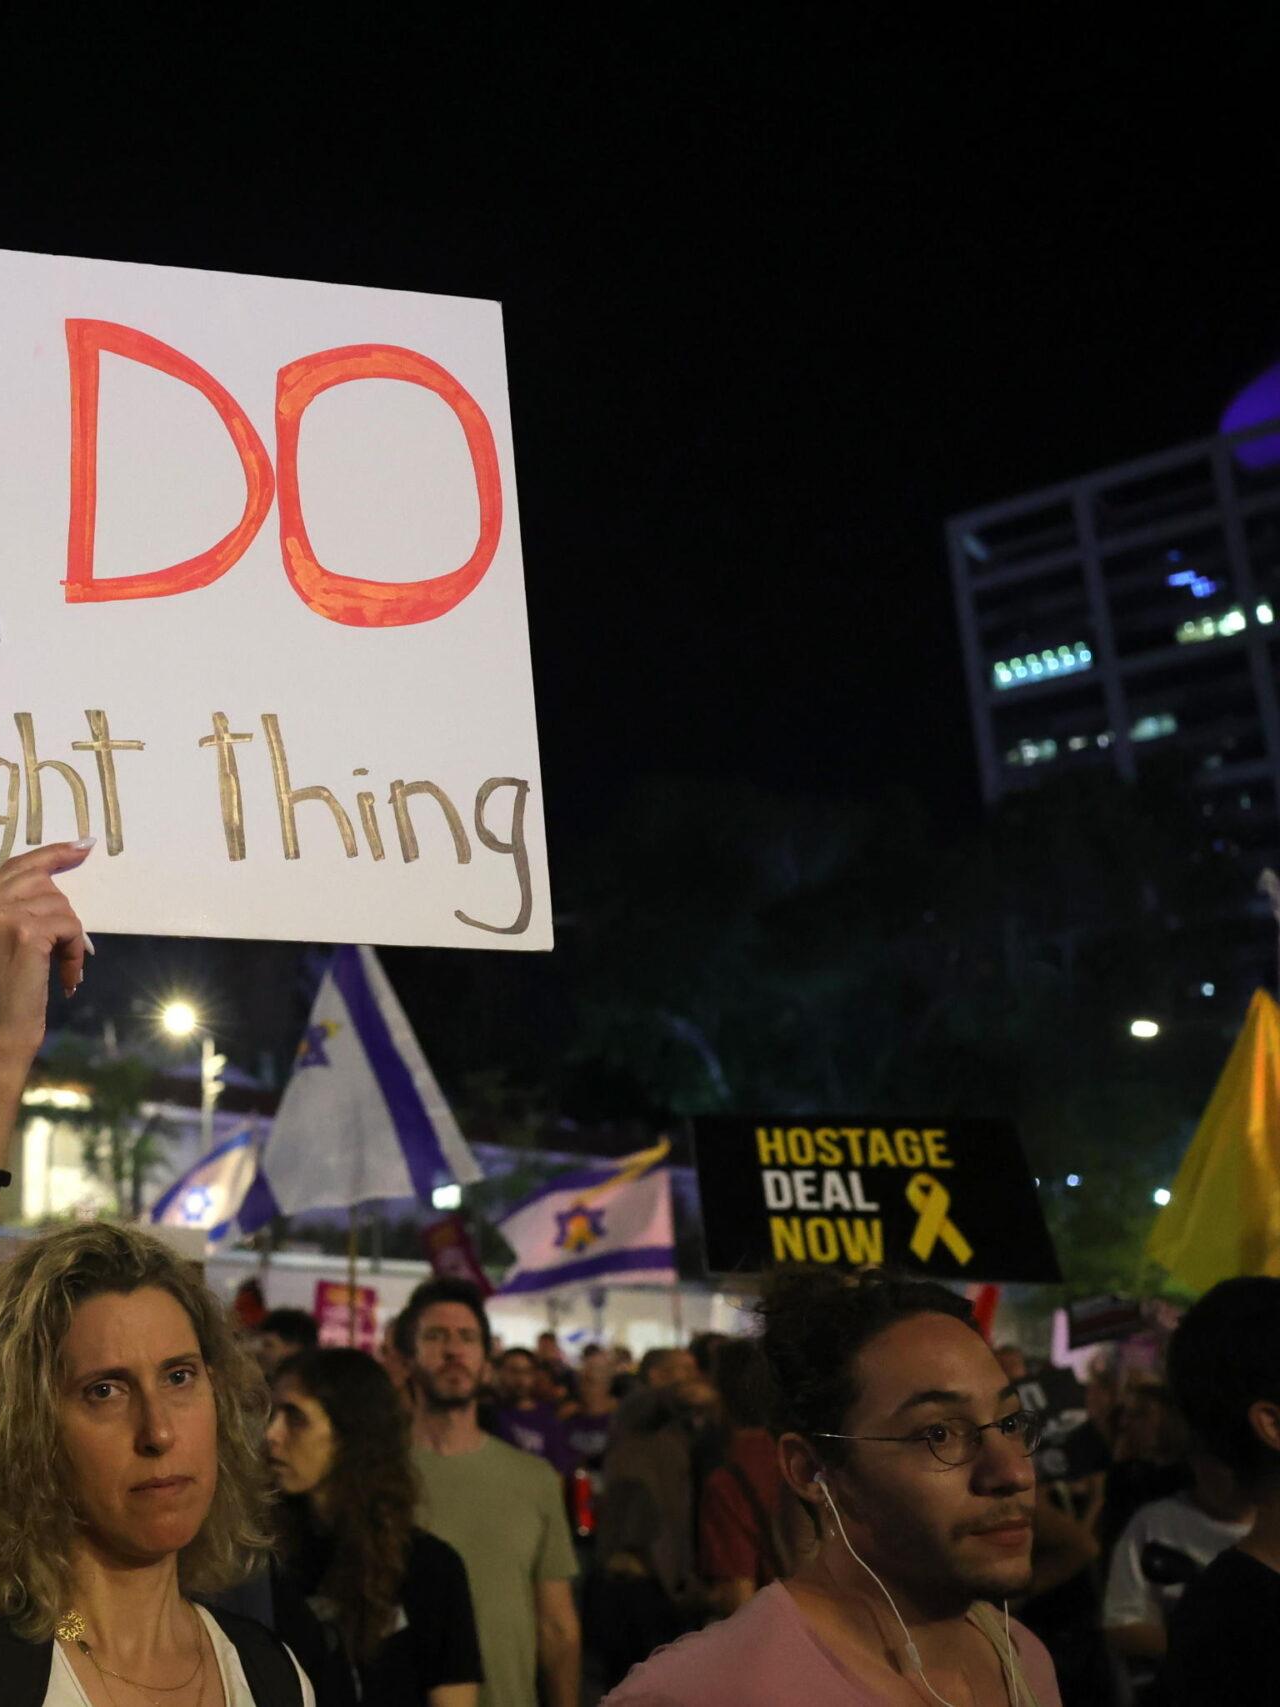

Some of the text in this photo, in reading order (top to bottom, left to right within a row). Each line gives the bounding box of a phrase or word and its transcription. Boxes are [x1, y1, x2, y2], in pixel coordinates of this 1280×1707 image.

[61, 318, 503, 628] DO
[197, 711, 533, 935] thing
[756, 1127, 954, 1168] HOSTAGE
[763, 1170, 879, 1212] DEAL
[770, 1216, 883, 1264] NOW
